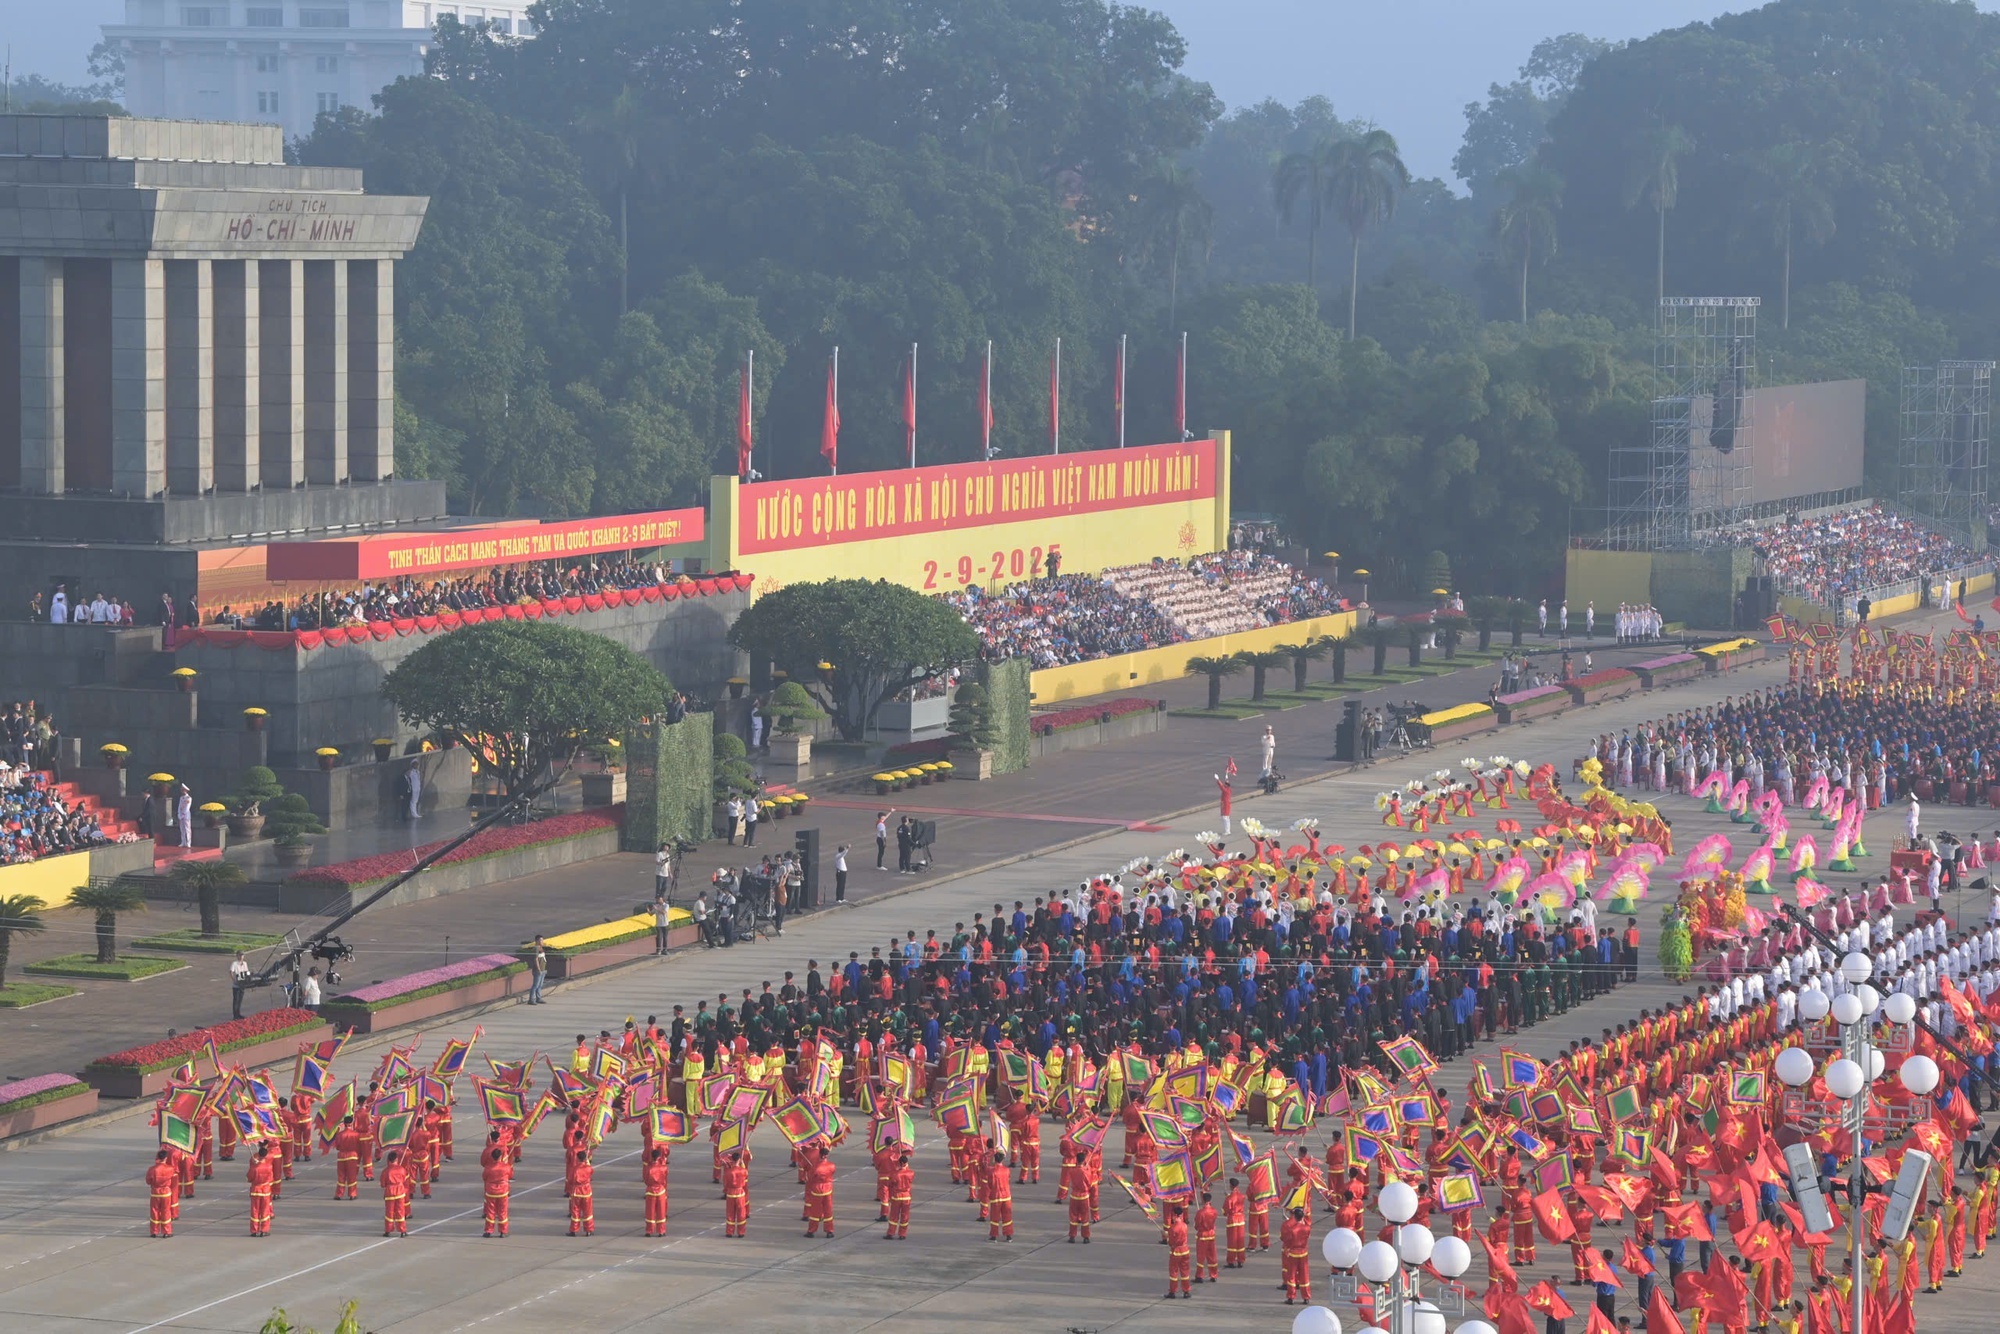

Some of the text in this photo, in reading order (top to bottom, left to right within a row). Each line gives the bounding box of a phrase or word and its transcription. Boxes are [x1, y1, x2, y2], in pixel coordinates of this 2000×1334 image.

[756, 488, 803, 541] NƯỚC
[811, 484, 857, 541] CỘNG
[865, 479, 896, 528] HÒA
[904, 476, 923, 523] XÃ
[930, 472, 957, 526] HỘI
[964, 465, 994, 517] CHỦ
[1001, 465, 1046, 512] NGHĨA
[1052, 460, 1083, 512] VIỆT
[1088, 462, 1117, 501] NAM
[1123, 453, 1160, 497] MUÔN
[388, 549, 413, 569] TINH
[443, 540, 469, 563] CÁCH
[471, 539, 498, 563] MẠNG
[499, 535, 530, 557] THÁNG
[531, 531, 551, 553] TÁM
[553, 529, 565, 551] VÀ
[566, 525, 590, 551] QUỐC
[591, 525, 621, 547] KHÁNH
[622, 525, 638, 543] 2-9
[640, 519, 657, 541] BẤT
